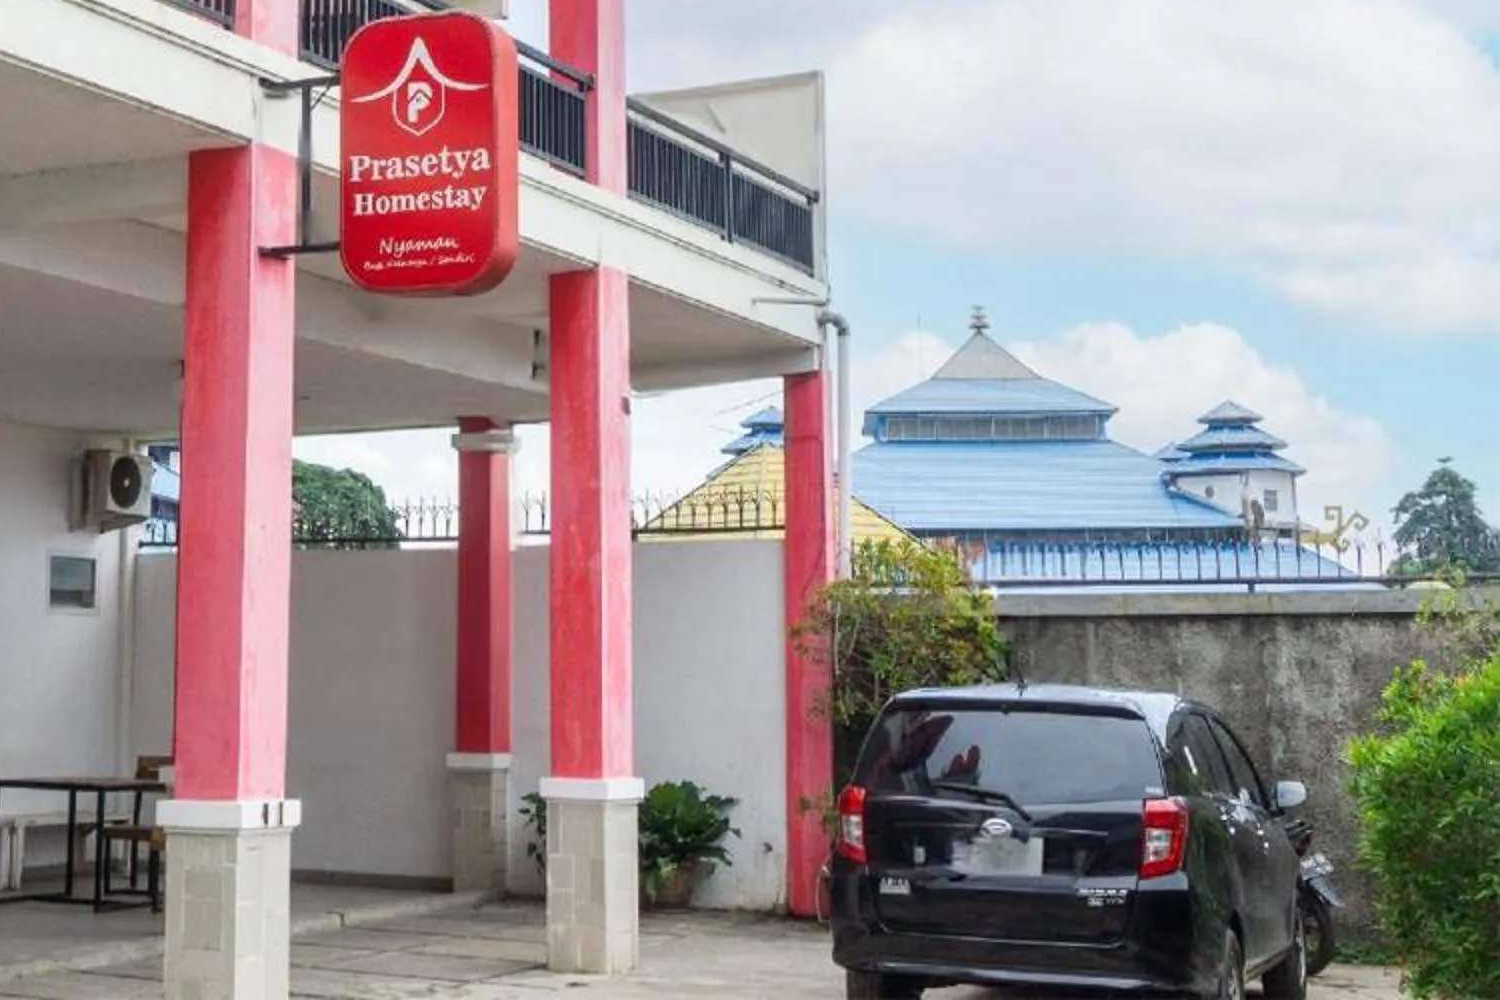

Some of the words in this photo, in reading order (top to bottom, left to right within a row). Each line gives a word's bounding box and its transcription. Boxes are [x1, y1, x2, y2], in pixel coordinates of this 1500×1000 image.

[350, 145, 490, 182] Prasetya
[354, 184, 486, 215] Homestay
[379, 236, 459, 258] Nyaman
